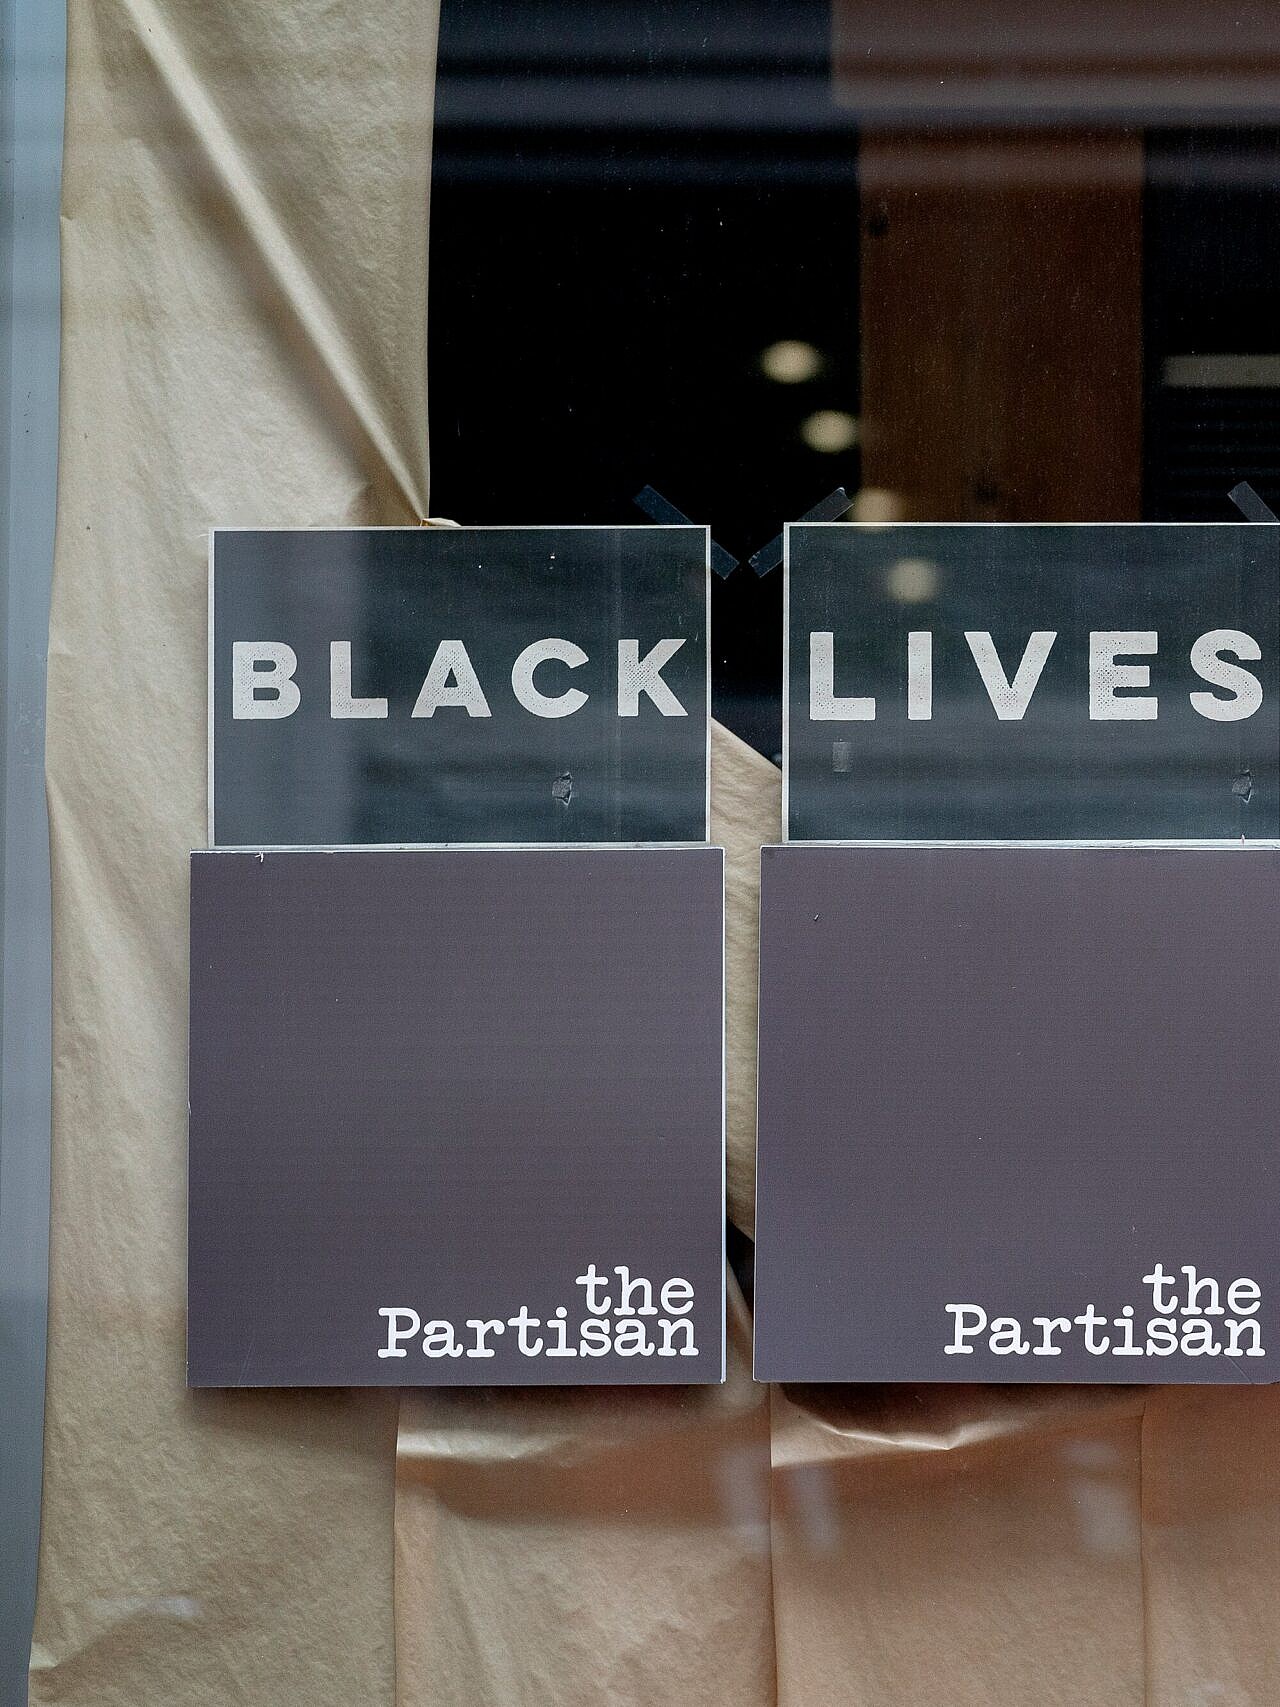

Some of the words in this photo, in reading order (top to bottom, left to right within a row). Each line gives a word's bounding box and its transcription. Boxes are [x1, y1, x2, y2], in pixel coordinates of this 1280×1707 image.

[232, 638, 688, 721] BLACK
[810, 629, 1263, 721] LIVES
[575, 1263, 695, 1315] the
[1142, 1263, 1262, 1315] the
[377, 1305, 699, 1359] Partisan
[943, 1303, 1266, 1356] Partisan
